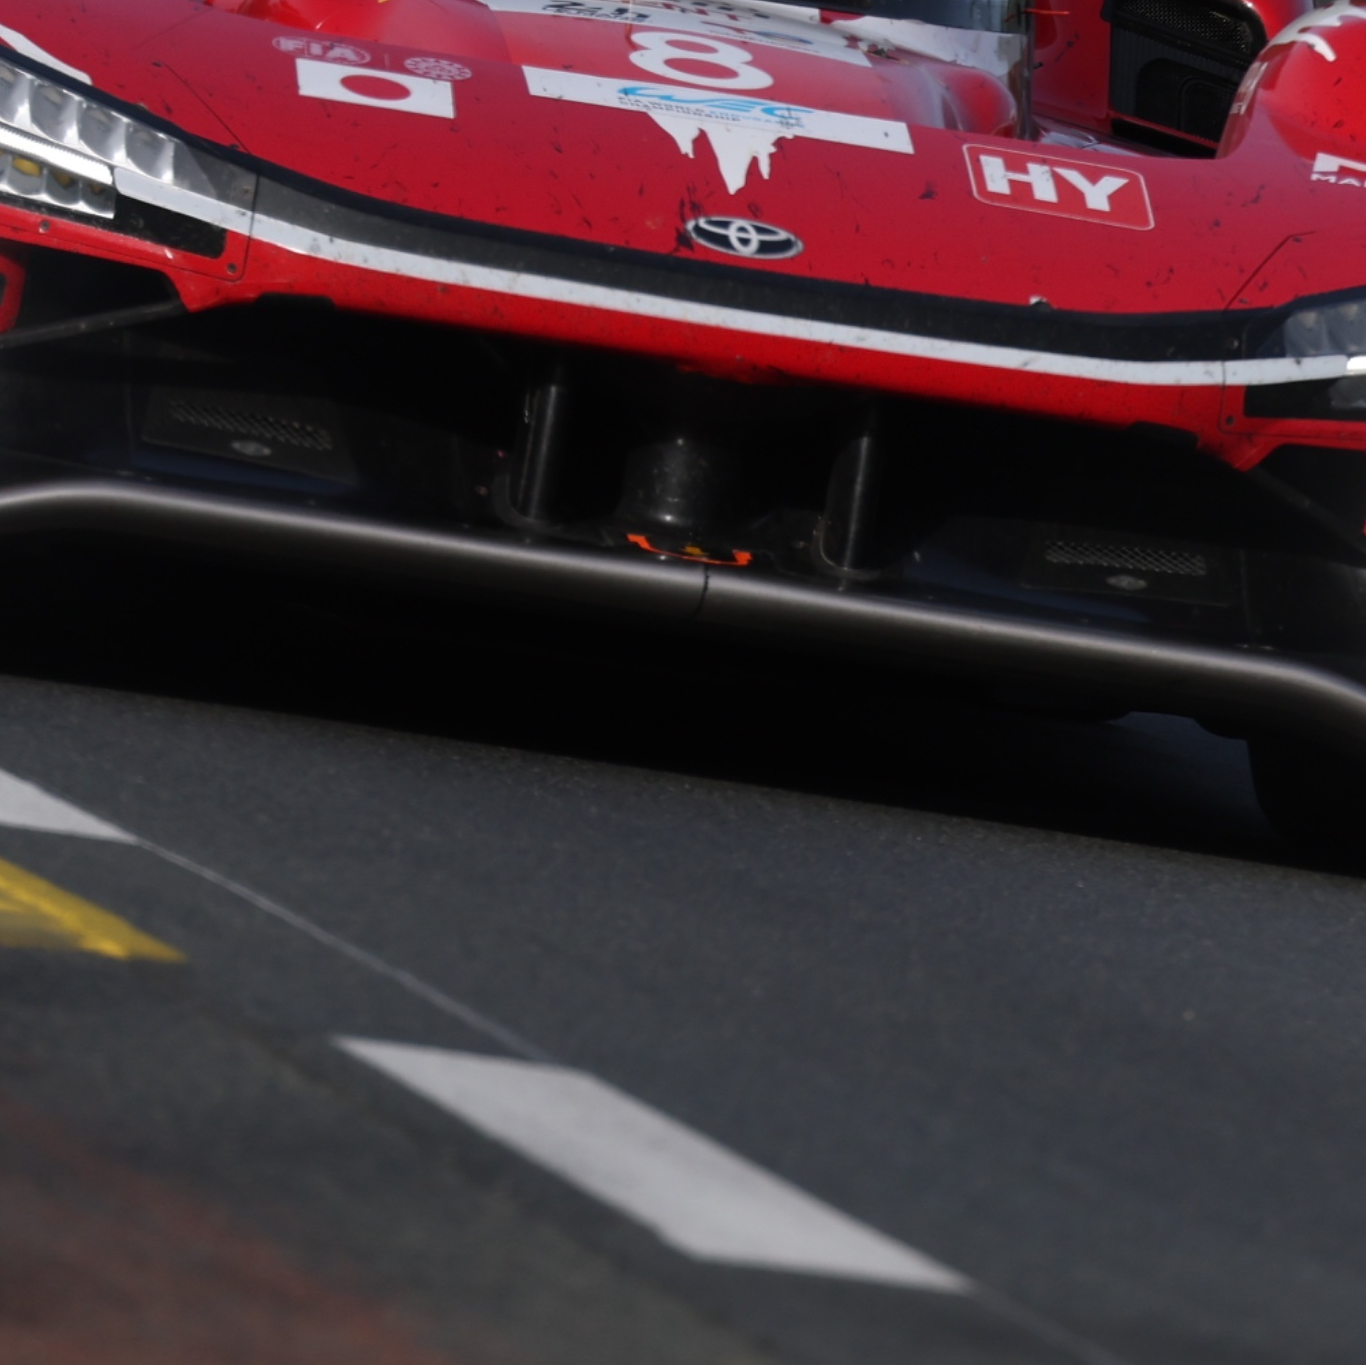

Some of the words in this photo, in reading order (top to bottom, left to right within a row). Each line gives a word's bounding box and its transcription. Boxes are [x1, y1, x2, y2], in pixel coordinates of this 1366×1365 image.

[278, 36, 359, 62] FIA
[628, 31, 775, 91] 8
[617, 86, 816, 121] WEC
[979, 154, 1129, 212] HY
